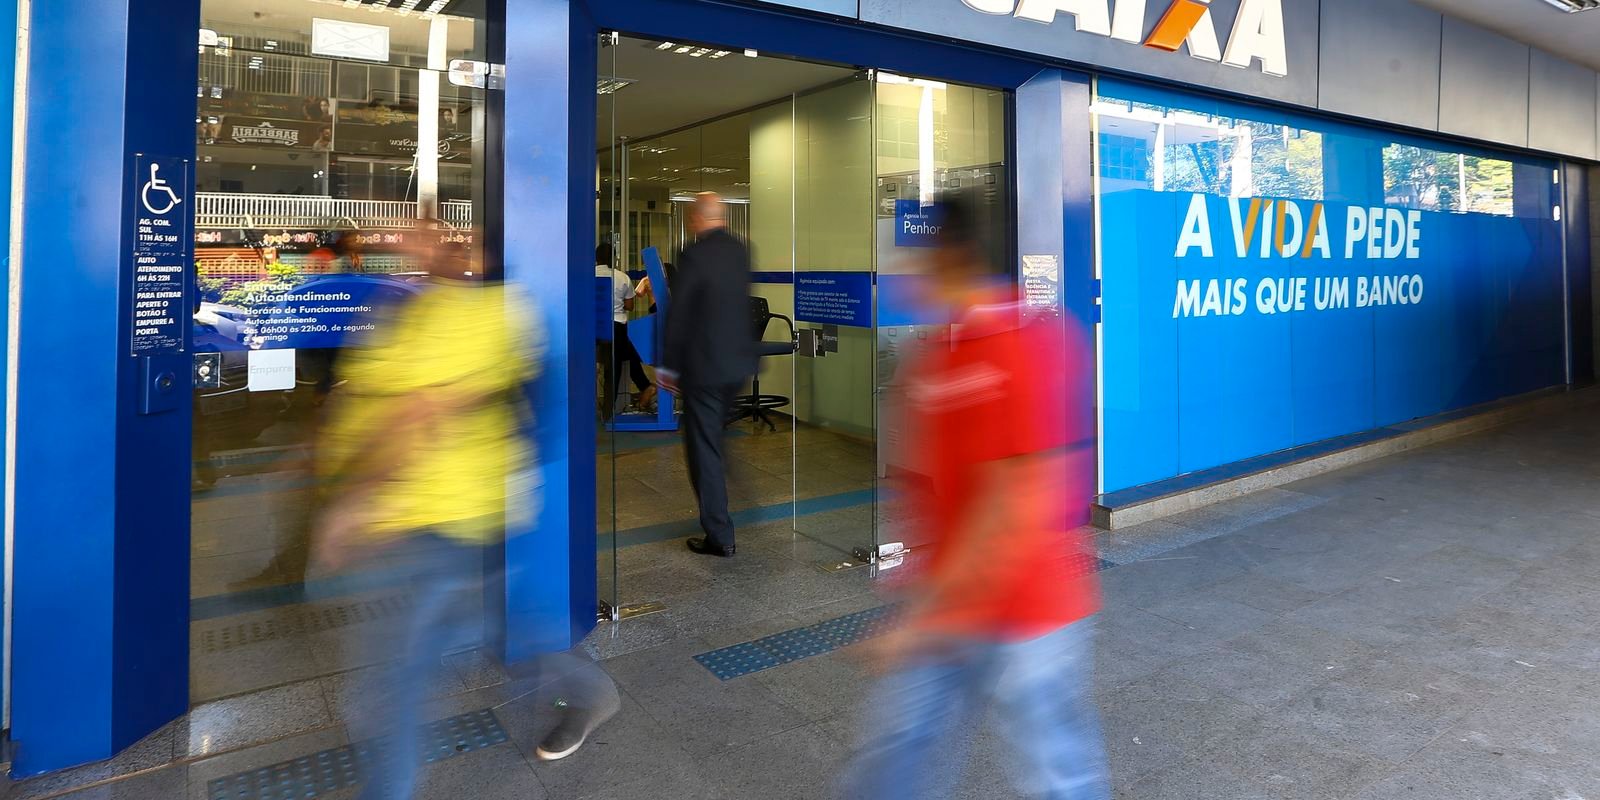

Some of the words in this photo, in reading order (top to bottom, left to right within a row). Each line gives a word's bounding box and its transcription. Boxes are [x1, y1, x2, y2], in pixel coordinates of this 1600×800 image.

[903, 221, 942, 235] Penhor
[1174, 194, 1213, 257] A
[1228, 197, 1331, 258] VIDA
[1345, 206, 1422, 259] PEDE
[245, 282, 293, 291] Entrada
[246, 292, 351, 302] Autoatendimento
[1172, 278, 1247, 318] MAIS
[1256, 277, 1306, 314] QUE
[1314, 276, 1349, 310] UM
[1356, 274, 1423, 308] BANCO
[136, 308, 160, 317] BOTÃO
[245, 306, 282, 315] Horário
[284, 306, 297, 314] de
[299, 305, 372, 314] Funcionamento:
[136, 318, 167, 326] EMPURRE
[244, 317, 317, 325] Autoatendimento
[260, 326, 288, 334] 06h00
[301, 324, 330, 333] 22h00,
[342, 323, 375, 332] segunda
[250, 365, 294, 376] Empurre
